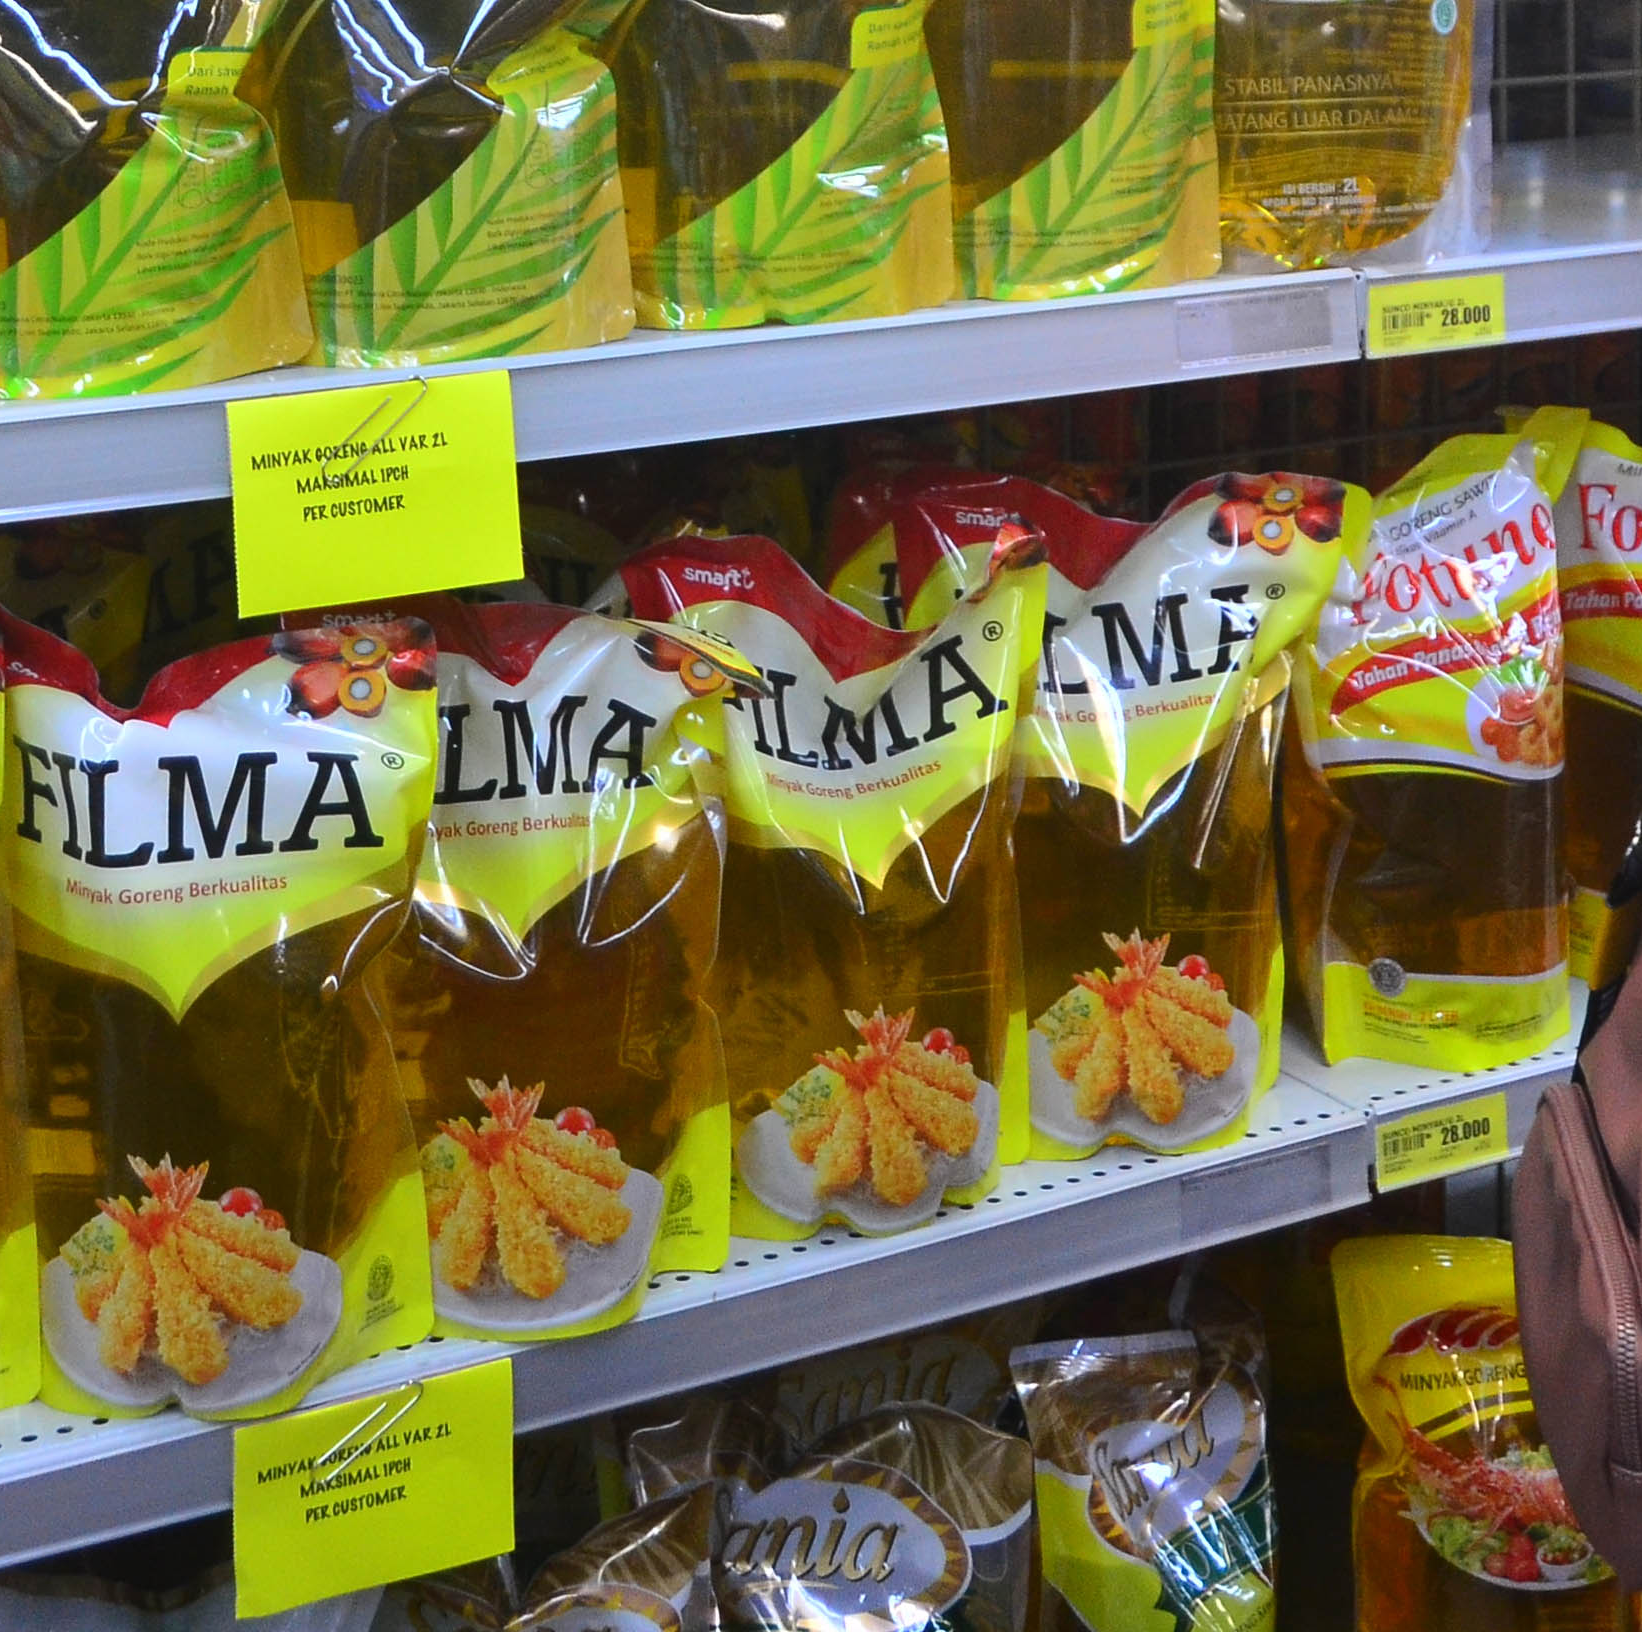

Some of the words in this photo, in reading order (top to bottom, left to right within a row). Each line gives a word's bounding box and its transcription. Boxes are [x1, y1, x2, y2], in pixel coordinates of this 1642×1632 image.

[1224, 75, 1289, 96] STABIL
[1293, 73, 1394, 94] PANASNYA
[1440, 304, 1491, 328] 28.000
[251, 446, 313, 471] MINYAK
[314, 439, 370, 463] GORENG
[371, 436, 396, 456] ALL
[399, 433, 429, 452] VAR
[431, 431, 448, 448] 2L
[295, 467, 378, 495] MAKSIMAL
[302, 504, 329, 523] PER
[330, 494, 406, 518] CUSTOMER
[1564, 591, 1620, 611] Tahan
[1355, 661, 1408, 690] Tahan
[723, 634, 1010, 771] ILMA
[433, 695, 658, 805] LMA
[806, 783, 855, 800] Goreng
[855, 758, 942, 795] Berkualitas
[13, 736, 385, 869] FILMA
[466, 820, 519, 838] Goreng
[64, 875, 114, 907] Minyak
[117, 884, 185, 907] Goreng
[188, 873, 288, 900] Berkualitas
[1440, 1116, 1491, 1147] 28.000
[1399, 1373, 1462, 1393] MINYAK
[256, 1455, 318, 1485] MINYAK
[375, 1433, 401, 1454] ALL
[403, 1428, 433, 1448] VAR
[434, 1423, 453, 1440] 2L
[299, 1465, 381, 1499] MAKSIMAL
[305, 1504, 332, 1524] PER
[332, 1485, 408, 1517] CUSTOMER
